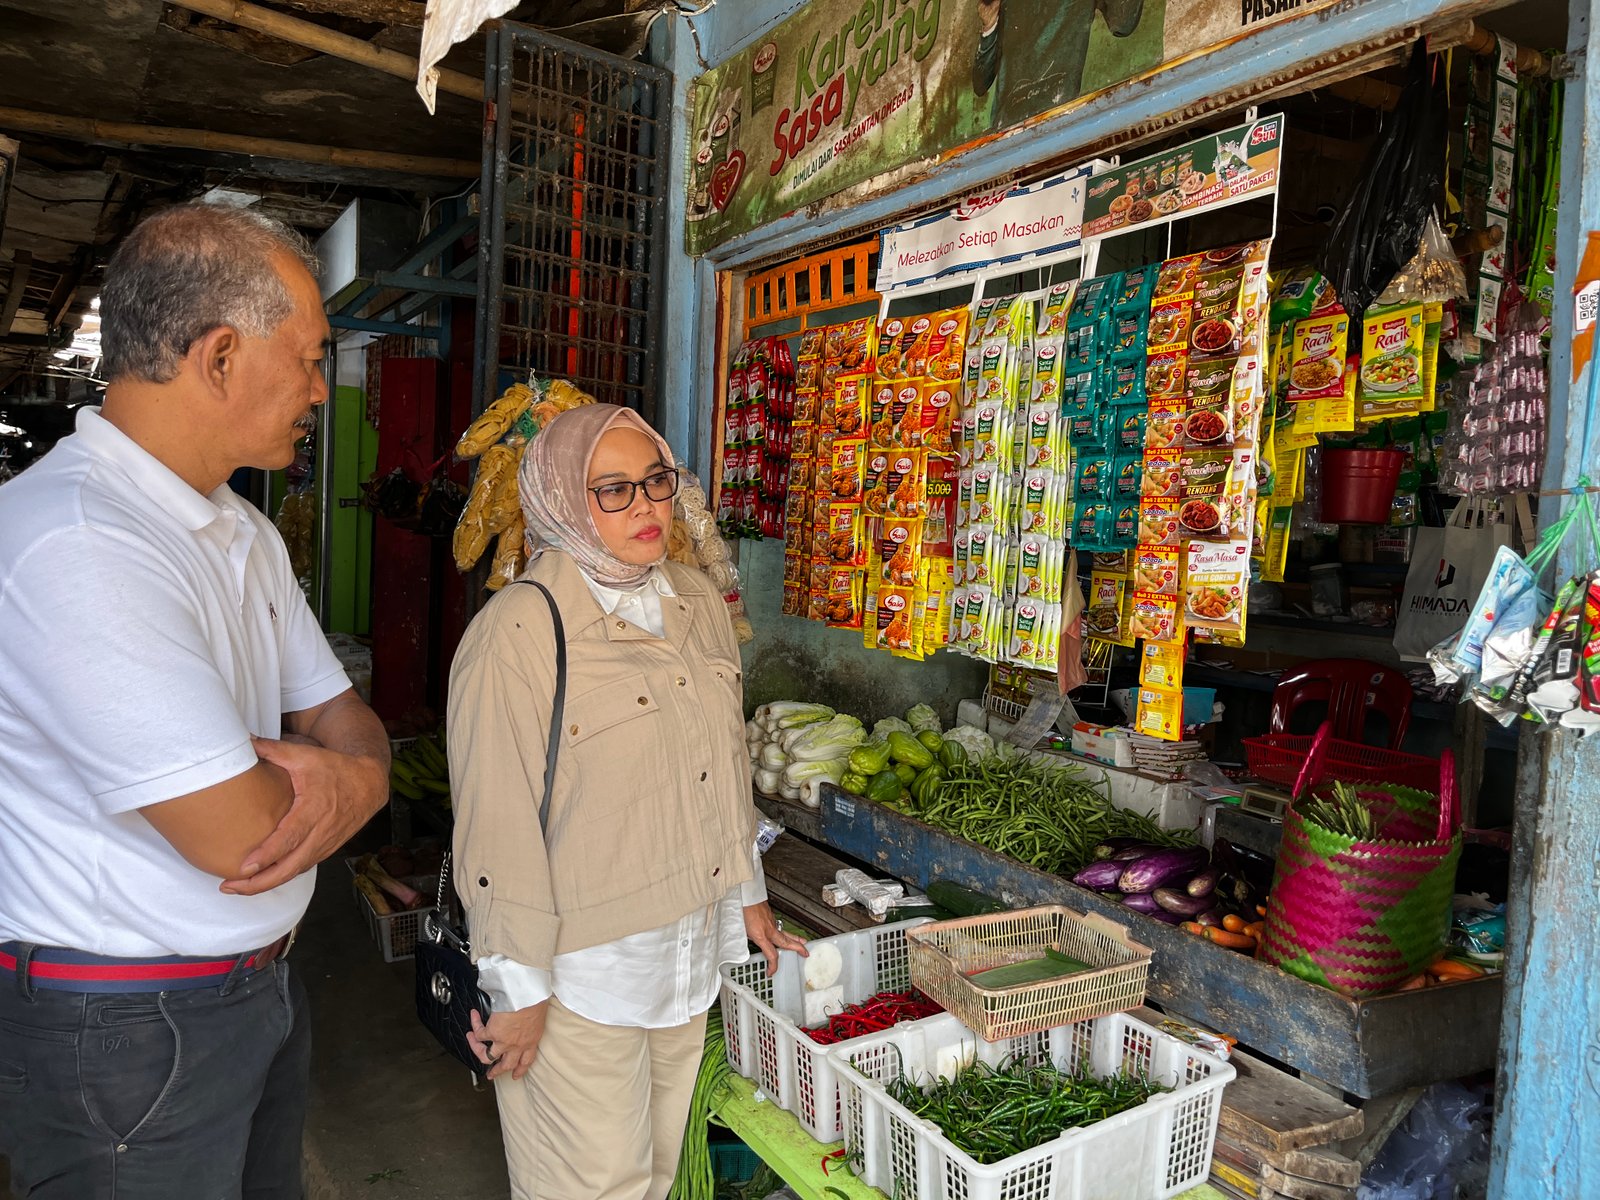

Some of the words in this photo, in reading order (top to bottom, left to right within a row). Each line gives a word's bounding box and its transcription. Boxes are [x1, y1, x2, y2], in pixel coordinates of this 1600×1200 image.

[1241, 0, 1301, 26] PAS
[793, 0, 911, 113] Karen
[793, 161, 817, 189] DIMULAI
[818, 147, 834, 169] DARI
[833, 132, 851, 157] SASA
[851, 110, 881, 142] SANTAN
[880, 88, 907, 120] OMEGA
[1229, 174, 1248, 188] DALAM
[1230, 181, 1248, 197] SATU
[1248, 168, 1275, 191] PAKET!
[1182, 181, 1224, 207] KOMBINASI
[1197, 191, 1223, 207] TERBAIK
[898, 240, 955, 268] Melezatkan
[958, 231, 998, 249] Setiap
[1002, 214, 1064, 240] Masakan
[1169, 294, 1187, 303] EXTRA
[1164, 344, 1181, 352] EXTRA
[1302, 332, 1334, 352] Racik
[1375, 325, 1410, 350] Racik
[1097, 586, 1117, 599] Racik
[1410, 595, 1470, 613] HIMADA
